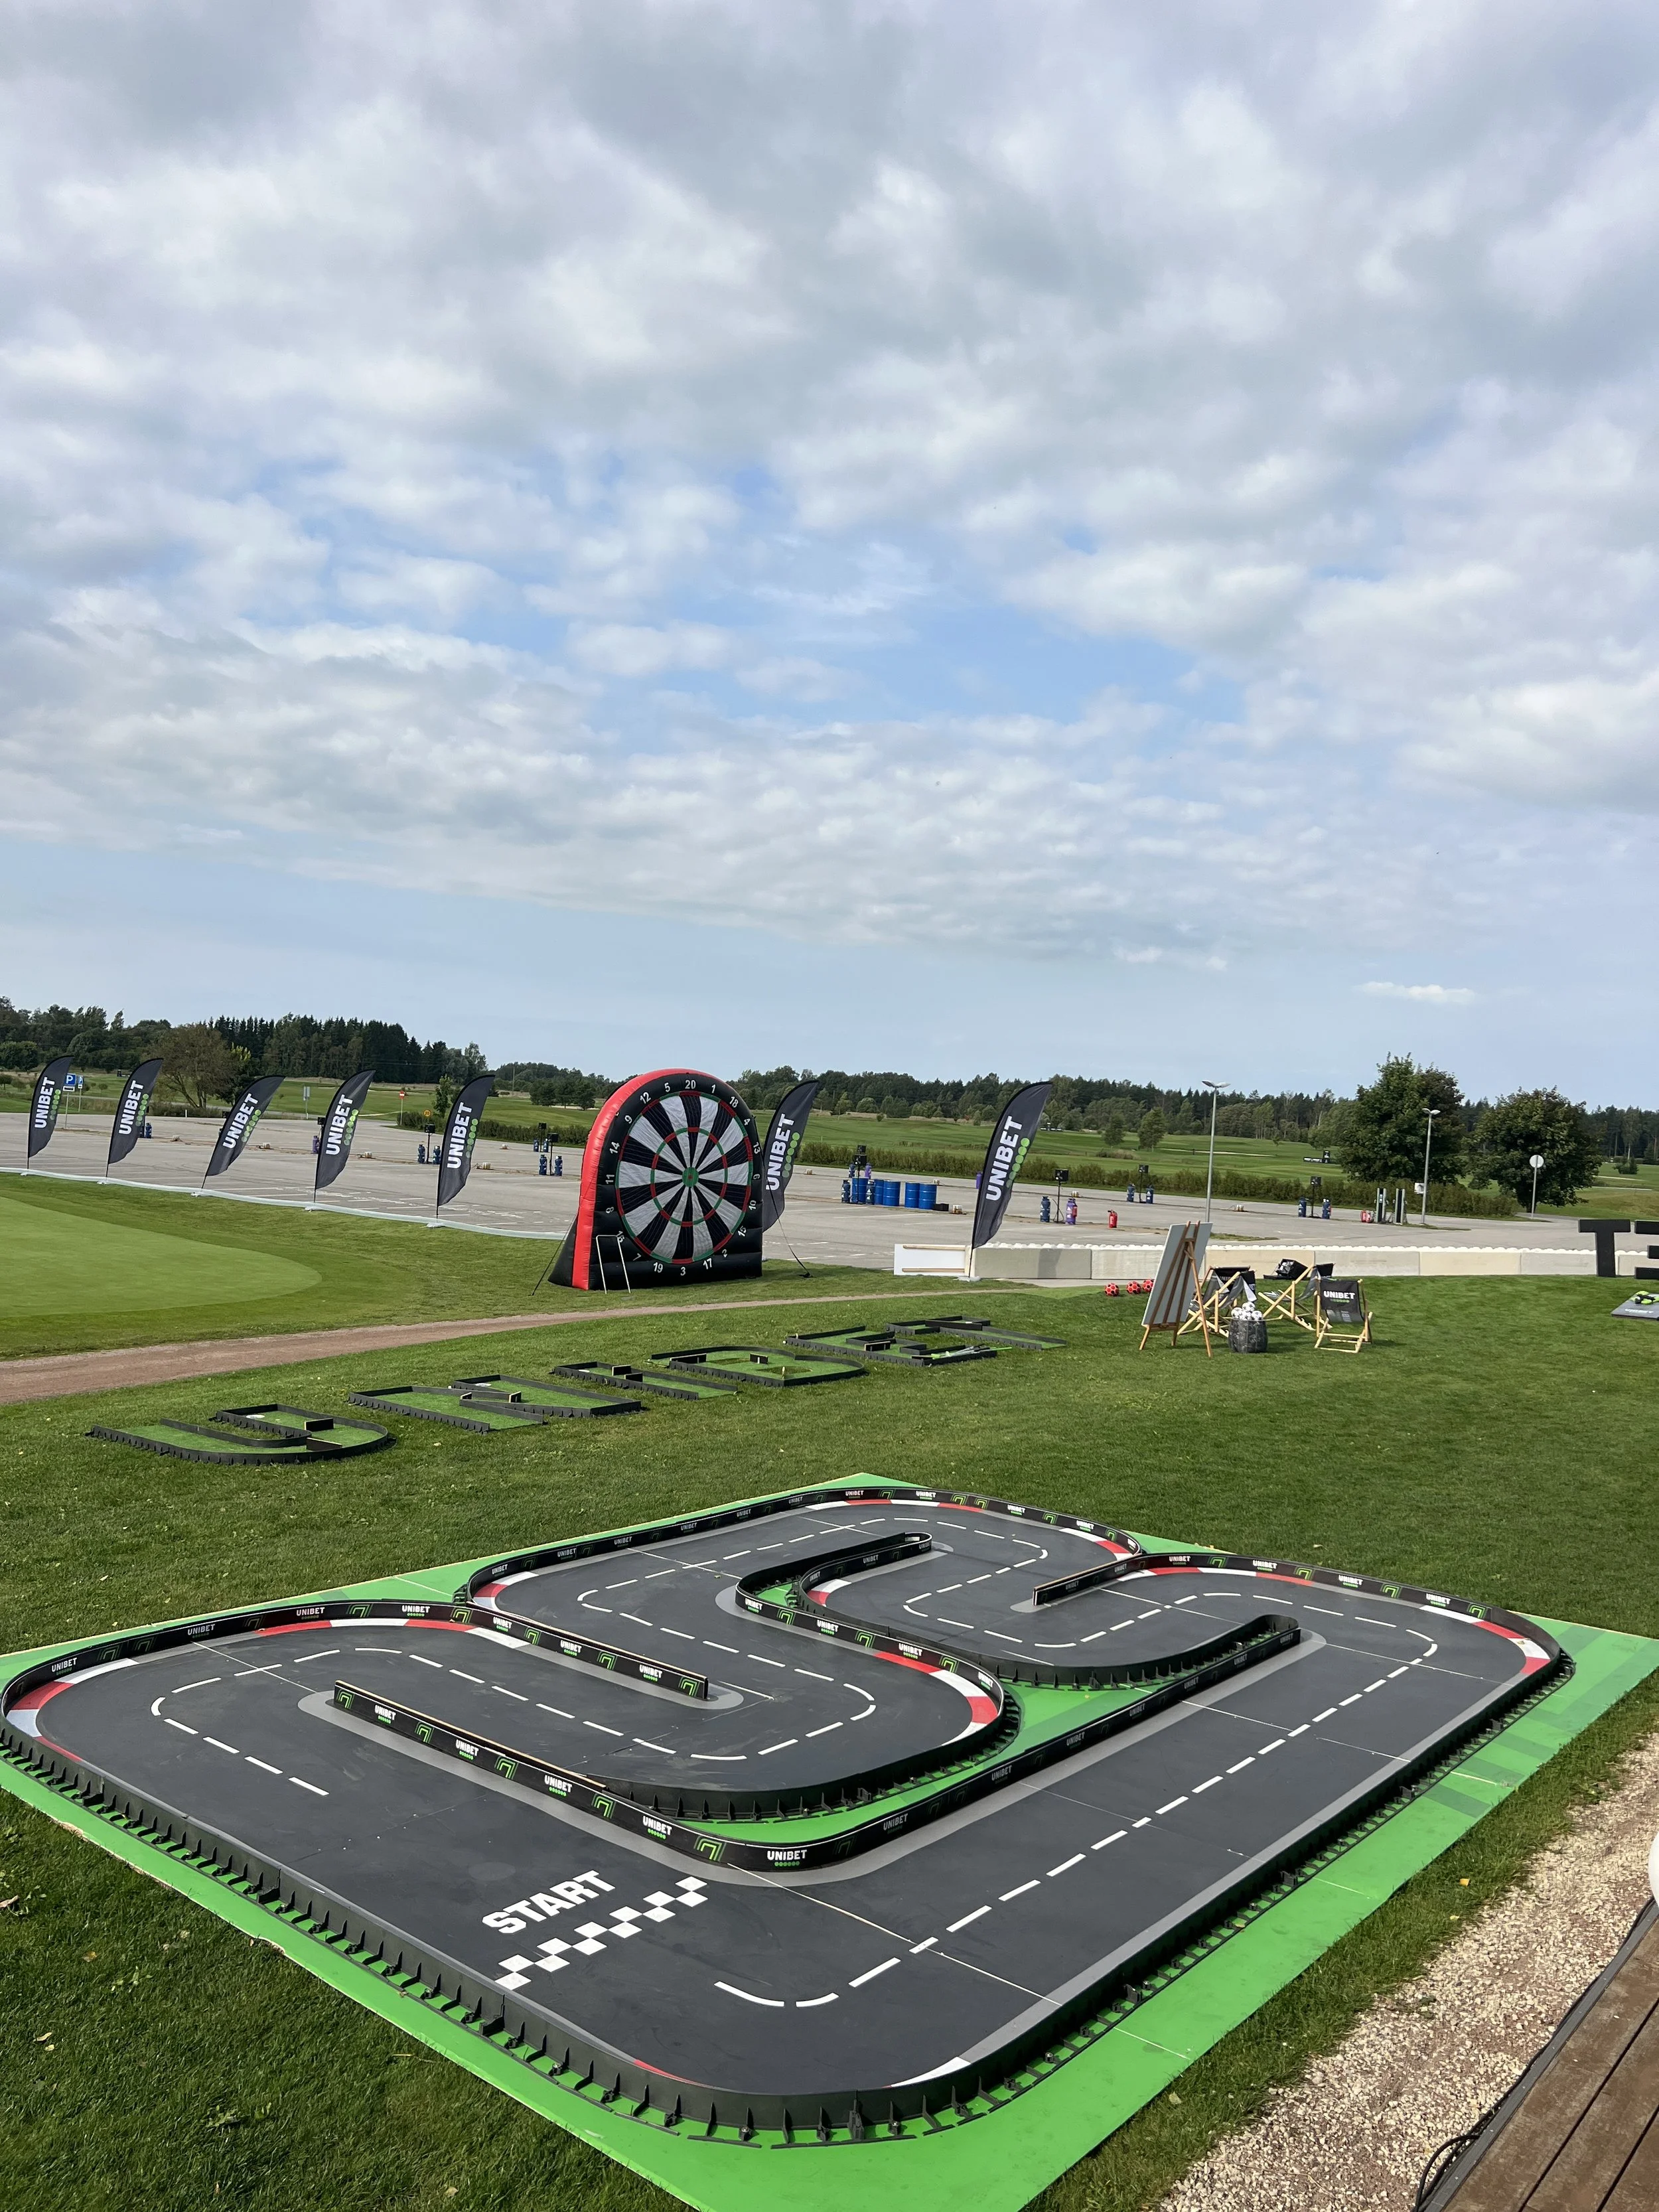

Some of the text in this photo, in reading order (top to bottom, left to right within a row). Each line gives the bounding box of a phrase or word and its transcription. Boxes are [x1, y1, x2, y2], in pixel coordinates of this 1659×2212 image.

[66, 1075, 73, 1084] P
[685, 1080, 696, 1089] 20
[664, 1082, 670, 1092] 5
[711, 1084, 716, 1093] 1
[35, 1077, 55, 1128] UNIBET
[640, 1092, 651, 1104] 12
[729, 1096, 739, 1108] 18
[119, 1080, 143, 1135] UNIBET
[222, 1093, 258, 1149] UNIBET
[326, 1094, 353, 1155] UNIBET
[624, 1115, 632, 1124] 9
[447, 1102, 472, 1169] UNIBET
[610, 1142, 620, 1154] 14
[753, 1142, 760, 1154] 13
[766, 1114, 794, 1191] UNIBET
[985, 1116, 1022, 1201] UNIBET
[606, 1174, 614, 1184] 11
[749, 1200, 757, 1210] 10
[738, 1226, 747, 1236] 15
[722, 1249, 727, 1258] 2
[654, 1262, 663, 1273] 19
[703, 1258, 712, 1269] 17
[680, 1267, 686, 1276] 3
[1323, 1291, 1355, 1299] UNIBET
[1007, 1505, 1026, 1513] UNIBET
[681, 1522, 697, 1531] UNIBET
[1076, 1520, 1094, 1530] UNIBET
[614, 1536, 632, 1545] UNIBET
[557, 1548, 576, 1557] UNIBET
[863, 1554, 879, 1564] UNIBET
[1253, 1560, 1277, 1569] UNIBET
[492, 1564, 508, 1574] UNIBET
[1338, 1575, 1363, 1585] UNIBET
[745, 1598, 762, 1610] UNIBET
[1426, 1593, 1451, 1604] UNIBET
[297, 1607, 325, 1617] UNIBET
[493, 1617, 512, 1629] UNIBET
[817, 1620, 838, 1632] UNIBET
[188, 1624, 215, 1635] UNIBET
[560, 1640, 581, 1653] UNIBET
[899, 1643, 922, 1656] UNIBET
[52, 1658, 77, 1672] UNIBET
[1234, 1653, 1248, 1665] UNIBET
[639, 1664, 662, 1678] UNIBET
[1184, 1676, 1198, 1689] UNIBET
[375, 1705, 396, 1720] UNIBET
[1129, 1704, 1145, 1716] UNIBET
[1066, 1732, 1084, 1746] UNIBET
[456, 1739, 478, 1756] UNIBET
[992, 1765, 1011, 1781] UNIBET
[545, 1775, 572, 1792] UNIBET
[643, 1816, 672, 1835] UNIBET
[883, 1814, 908, 1831] UNIBET
[767, 1850, 807, 1861] UNIBET
[482, 1870, 615, 1933] START
